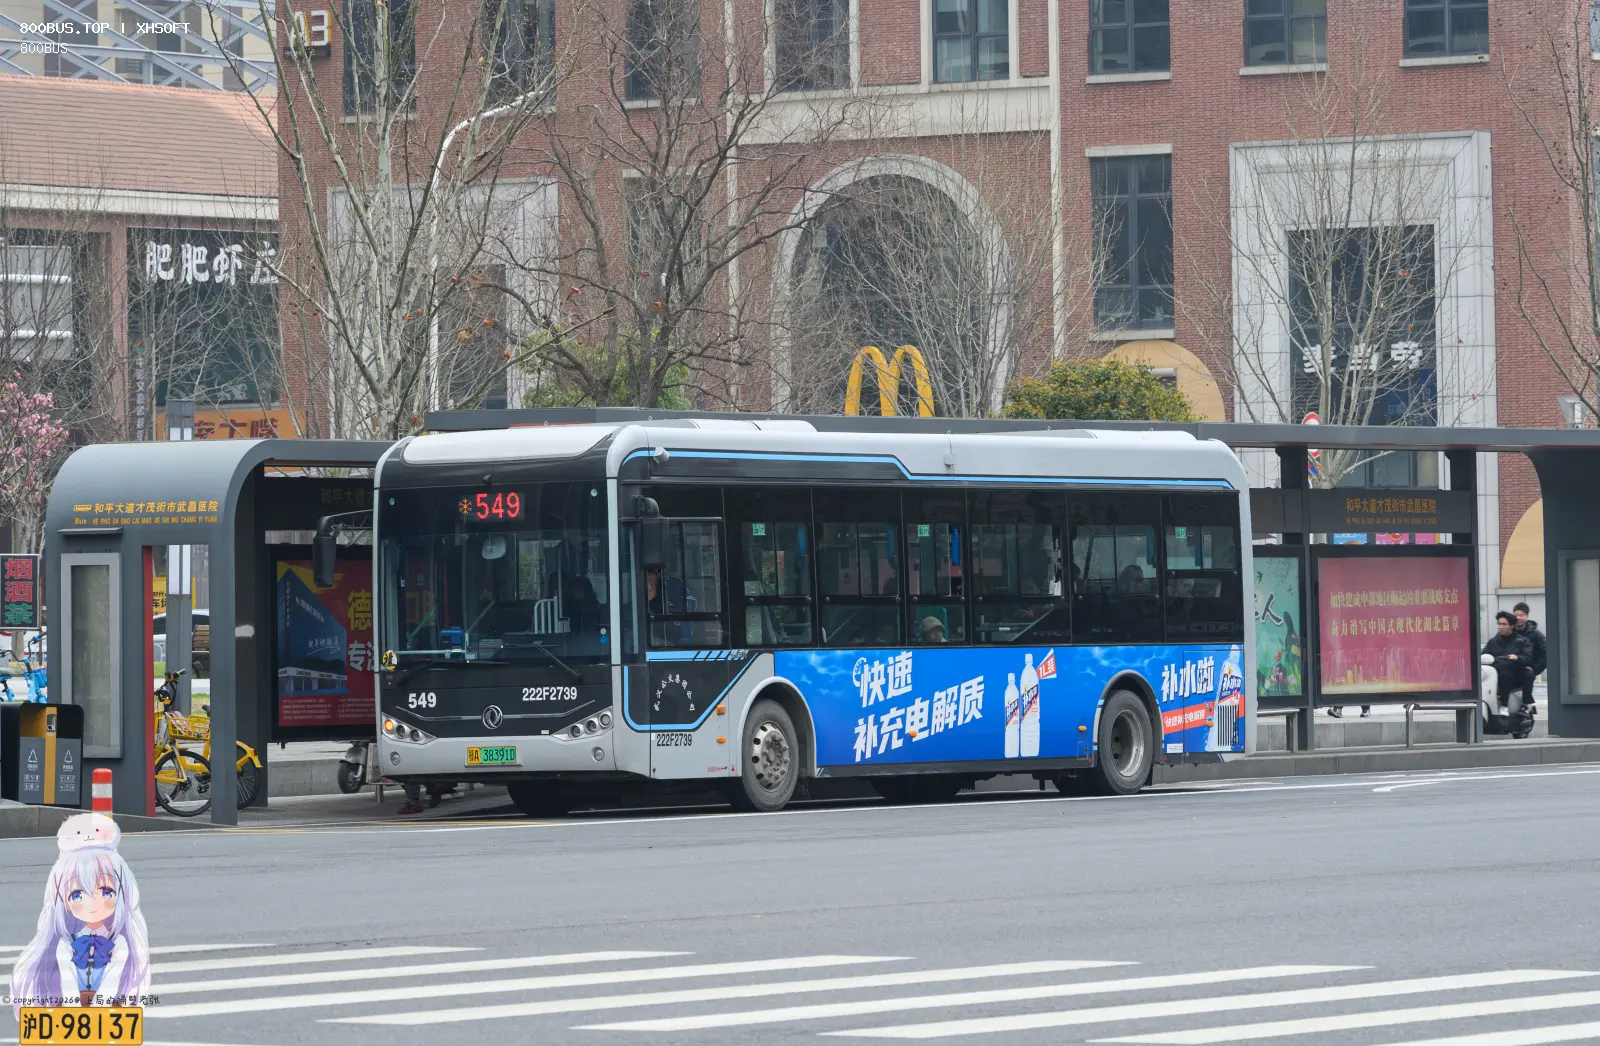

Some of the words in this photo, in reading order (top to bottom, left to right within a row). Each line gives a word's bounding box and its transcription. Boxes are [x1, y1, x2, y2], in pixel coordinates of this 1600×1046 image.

[94, 501, 218, 514] 和平大道才茂街市武昌医院
[476, 492, 520, 519] 549
[1346, 497, 1437, 513] 和平大道才茂街市武昌医院
[4, 558, 33, 624] 烟酒茶
[859, 651, 912, 708] 快速
[1161, 656, 1214, 703] 补水啦
[408, 692, 437, 709] 549
[522, 686, 578, 701] 222F2739
[853, 675, 985, 762] 补充电解质
[656, 733, 693, 747] 222F2739
